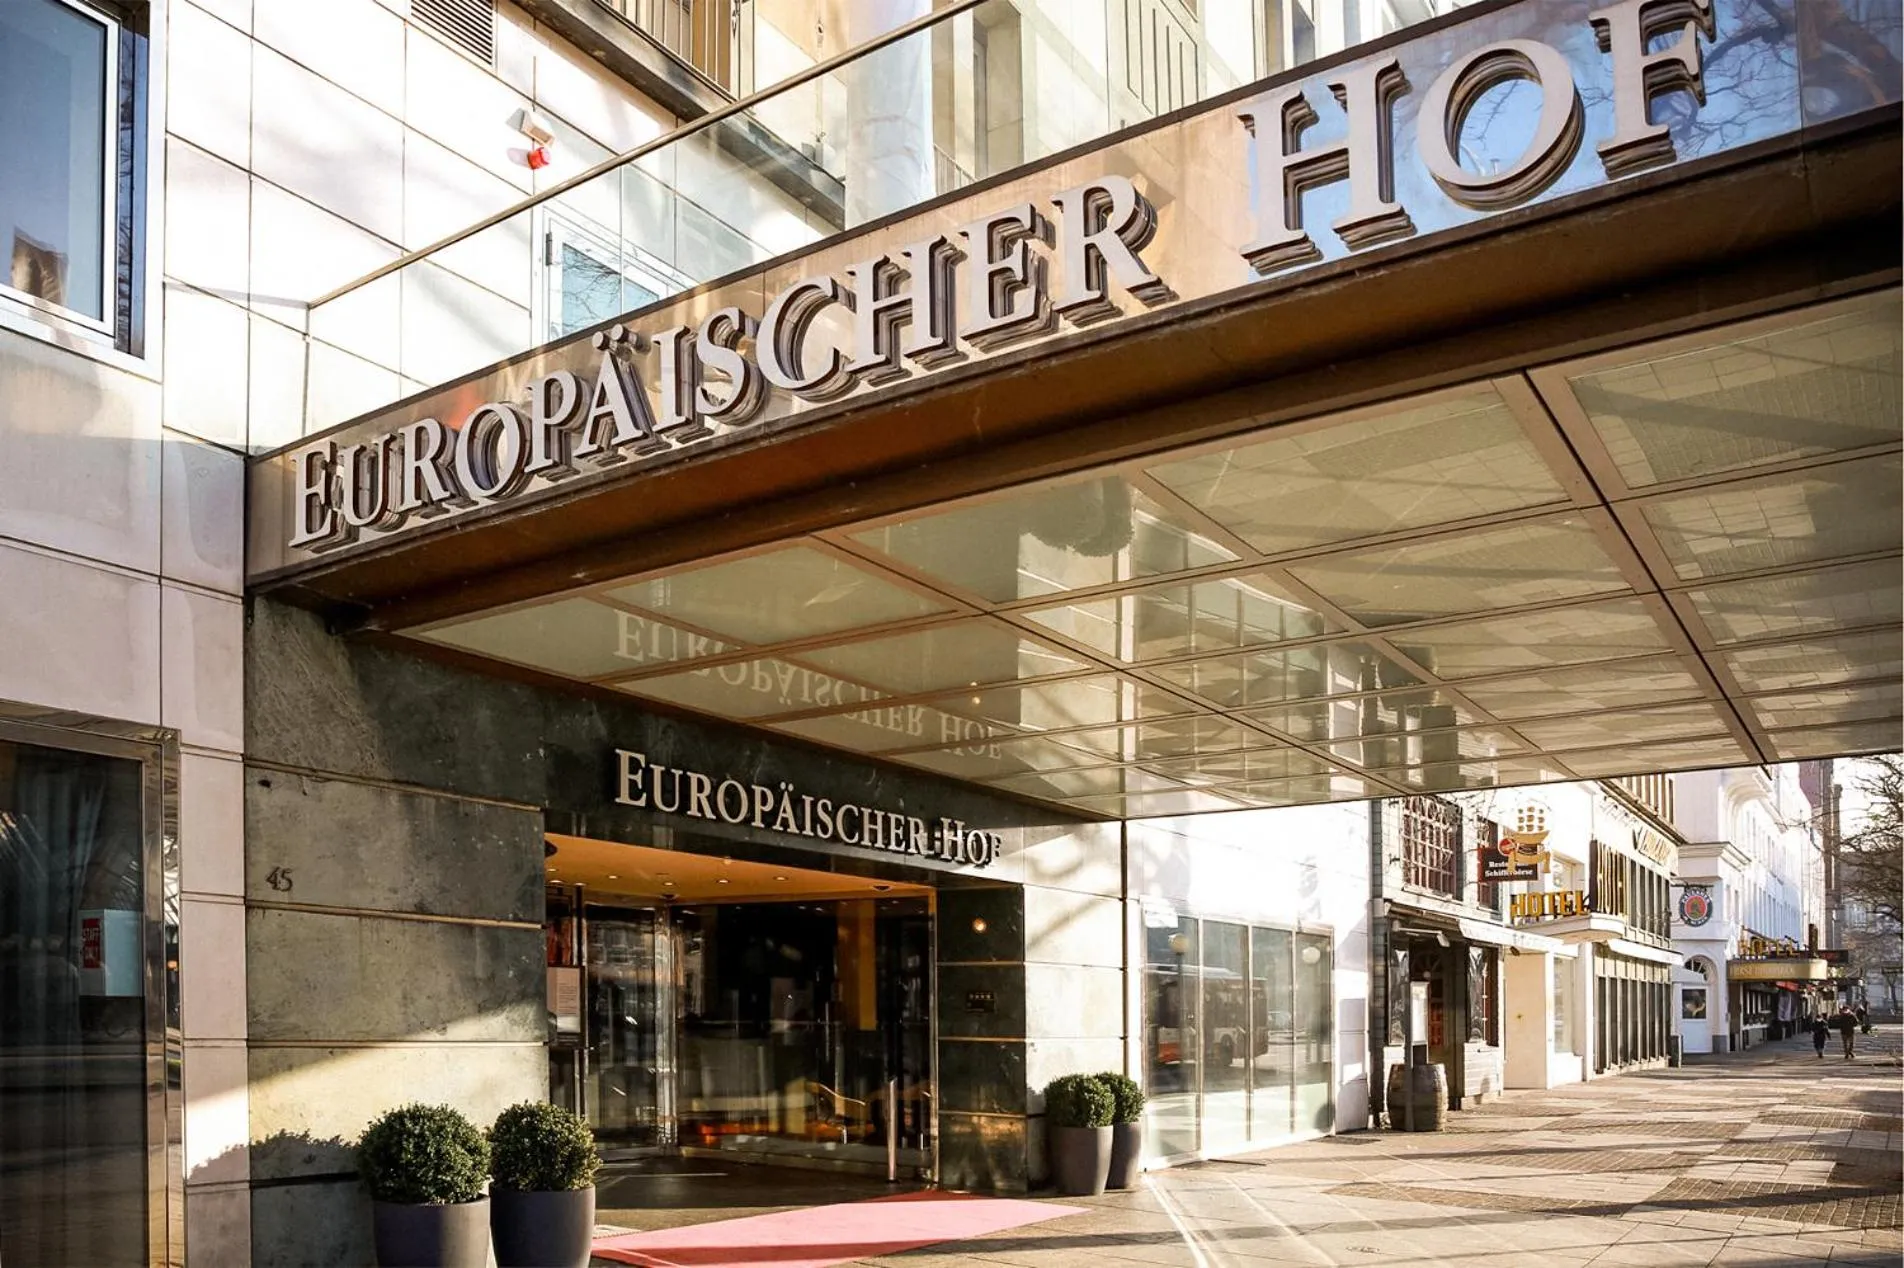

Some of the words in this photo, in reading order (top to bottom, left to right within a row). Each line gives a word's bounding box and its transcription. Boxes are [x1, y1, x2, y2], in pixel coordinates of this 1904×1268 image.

[287, 173, 1176, 553] EUROPÄISCHER
[1237, 0, 1715, 275] HOF
[613, 747, 936, 856] EUROPÄISCHER
[940, 816, 1003, 867] HOF
[265, 866, 294, 892] 45
[1510, 889, 1586, 918] HOTEL
